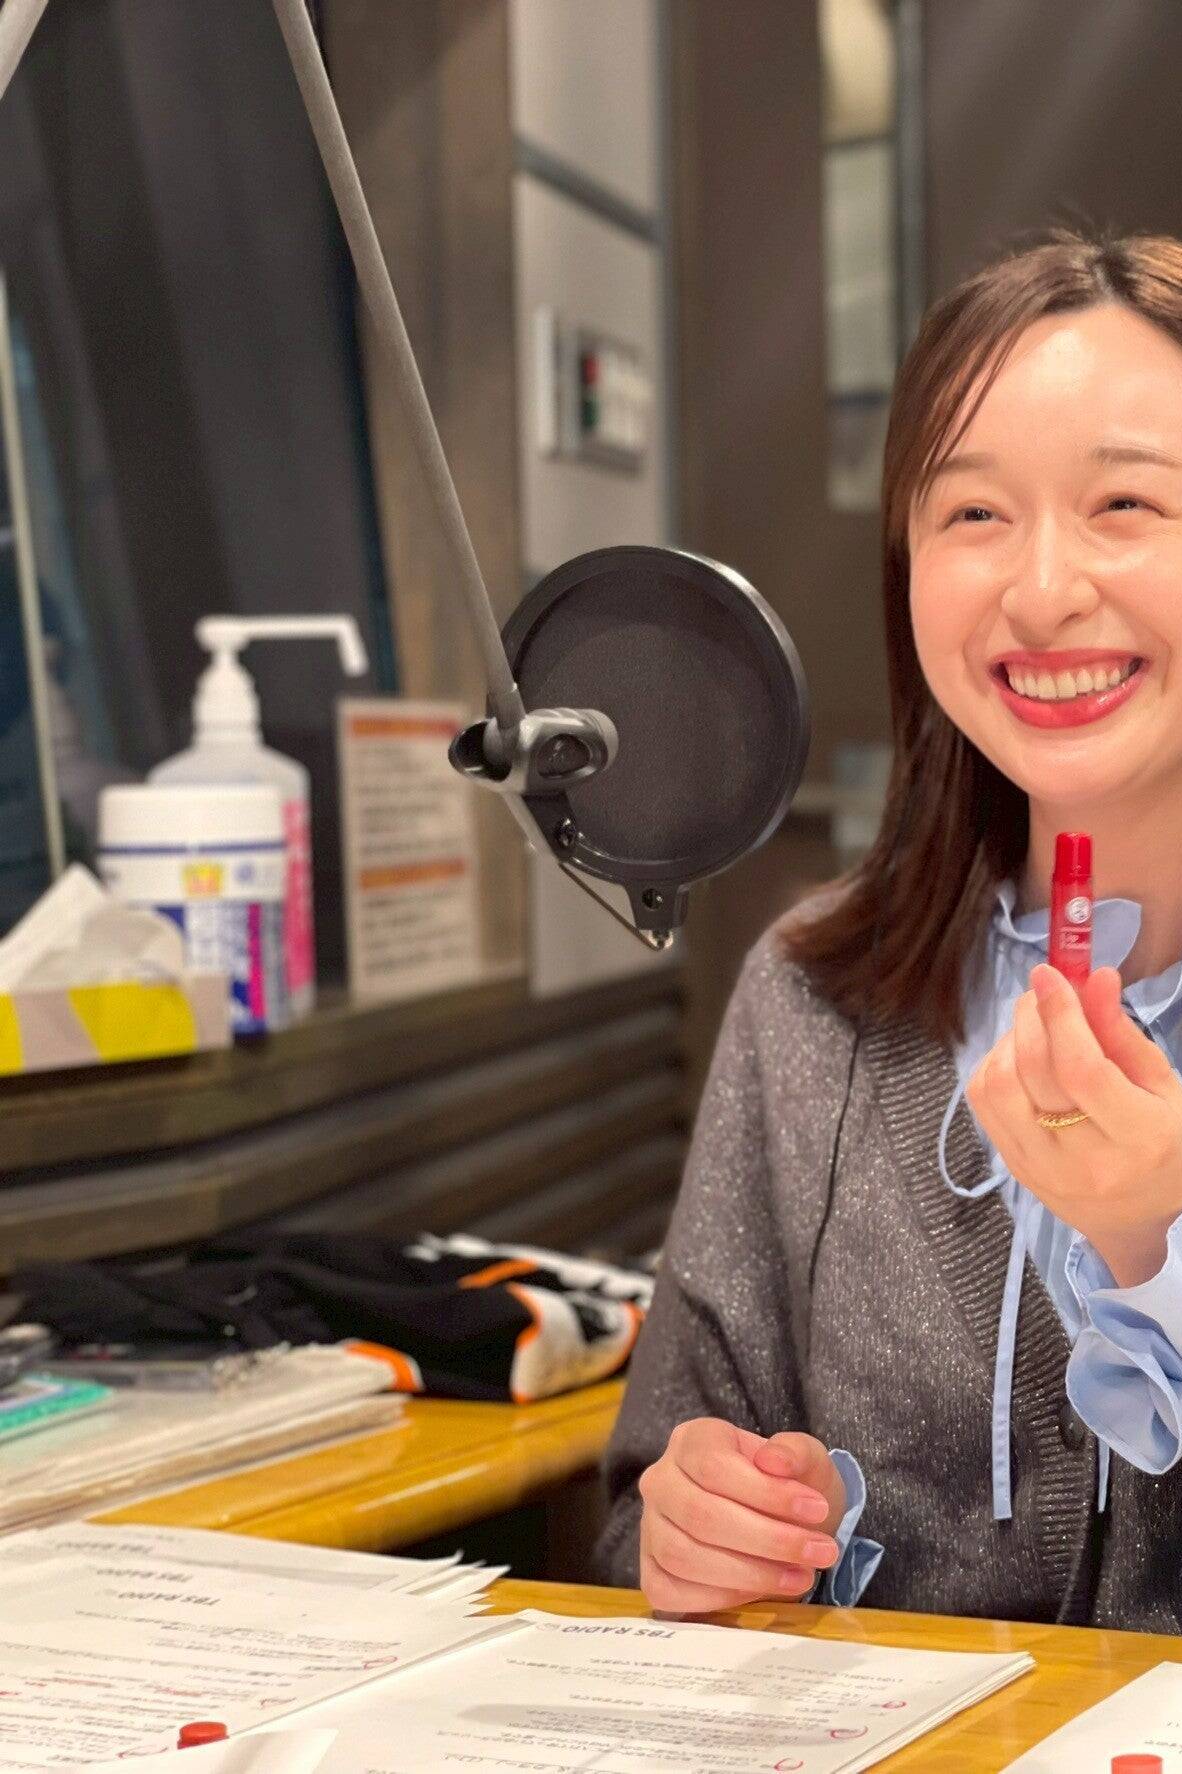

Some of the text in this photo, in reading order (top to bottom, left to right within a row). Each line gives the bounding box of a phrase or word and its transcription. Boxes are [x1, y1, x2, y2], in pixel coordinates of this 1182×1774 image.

[117, 1591, 220, 1606] TBS RADIO
[562, 1625, 632, 1636] RADIO
[634, 1628, 677, 1639] TBS
